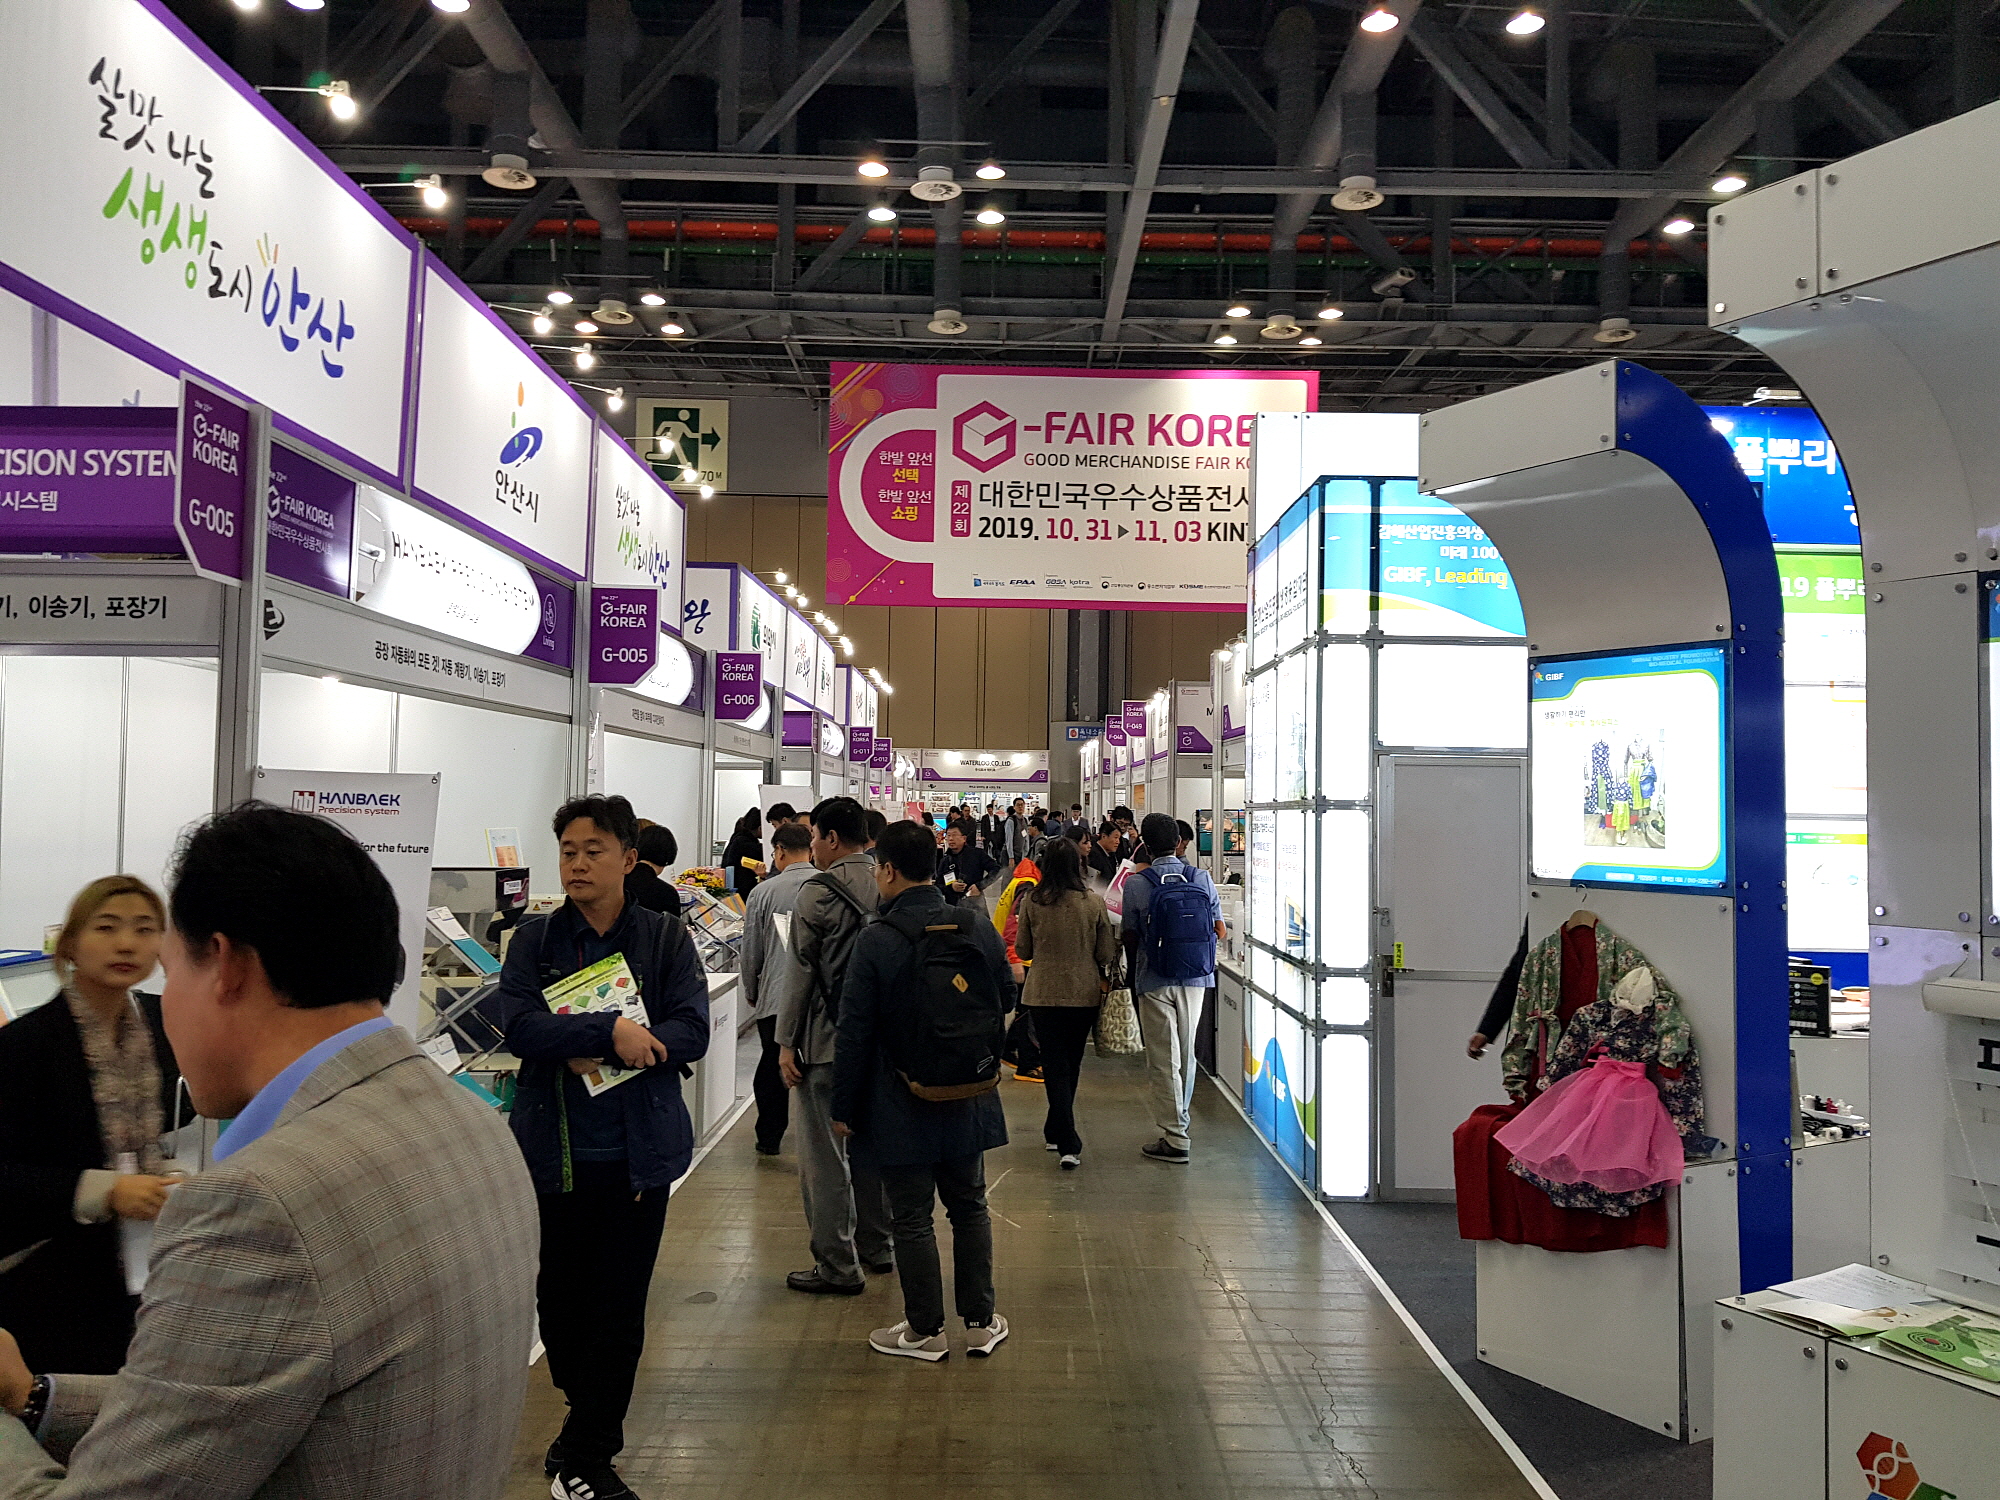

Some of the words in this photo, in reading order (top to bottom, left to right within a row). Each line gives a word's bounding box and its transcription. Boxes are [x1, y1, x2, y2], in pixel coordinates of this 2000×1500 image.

[193, 413, 240, 451] G-FAIR
[0, 449, 76, 476] ISION
[193, 438, 239, 476] KOREA
[879, 451, 904, 467] 한발
[908, 452, 933, 467] 앞선
[1024, 453, 1070, 466] GOOD
[1075, 455, 1190, 469] MERCHANDISE
[1195, 457, 1230, 469] FAIR
[892, 468, 919, 483] 선택
[0, 491, 58, 511] 시스템
[495, 469, 540, 523] 안산시
[878, 489, 903, 504] 한발
[907, 490, 932, 505] 앞선
[189, 499, 235, 537] G-005
[306, 503, 335, 530] KOREA
[891, 506, 919, 521] 쇼핑
[978, 516, 1039, 540] 2019.
[1207, 522, 1249, 542] KIN
[1471, 545, 1502, 561] 100
[1435, 566, 1508, 589] Leading
[28, 595, 96, 619] 이송기,
[105, 596, 167, 619] 포장기
[600, 601, 647, 615] G-FAIR
[600, 616, 647, 628] KOREA
[683, 598, 711, 634] 왕
[375, 640, 389, 661] 공장
[418, 652, 430, 670] 모든
[441, 658, 453, 676] 자동
[602, 647, 648, 663] G-005
[722, 662, 754, 672] G-FAIR
[722, 672, 754, 681] KOREA
[1545, 672, 1564, 681] GIBF
[723, 694, 755, 705] G-006
[318, 792, 401, 807] HANBAEK
[318, 805, 362, 815] Precision
[364, 807, 400, 817] system
[377, 842, 395, 853] the
[395, 843, 430, 854] future
